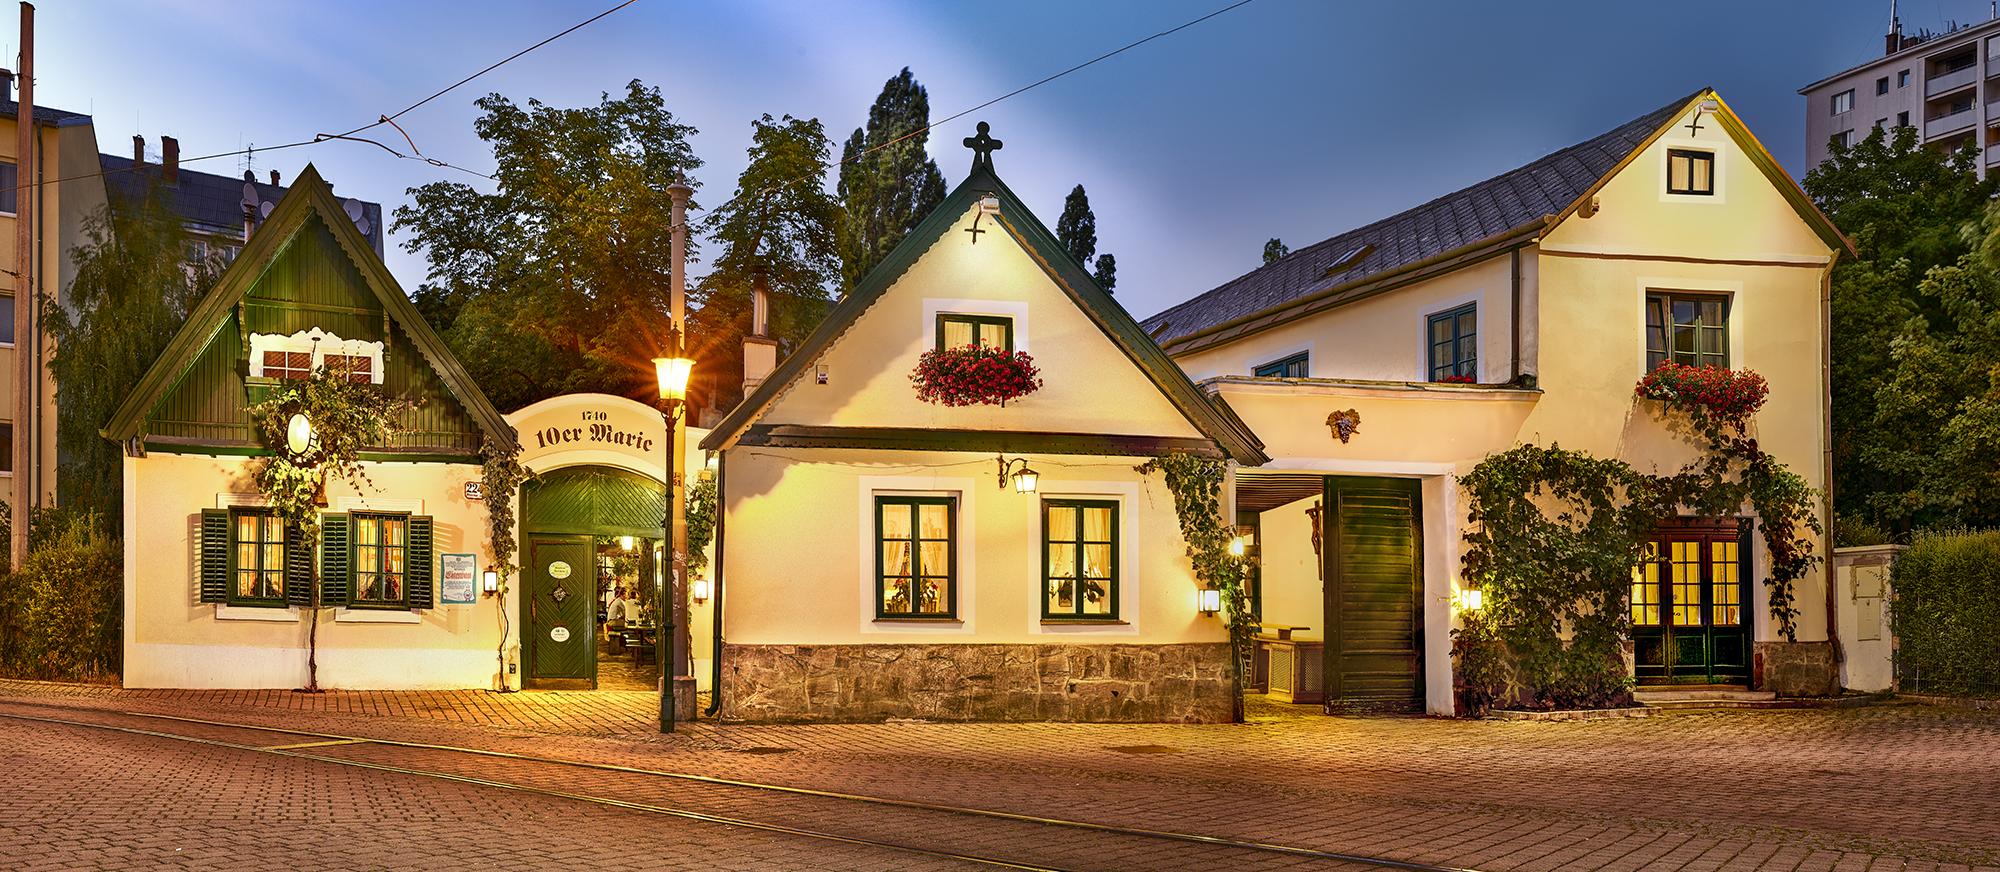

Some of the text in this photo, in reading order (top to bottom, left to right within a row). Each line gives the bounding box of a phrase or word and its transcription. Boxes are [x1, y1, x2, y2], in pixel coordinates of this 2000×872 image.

[582, 411, 607, 421] 1740
[536, 423, 653, 452] 10er Marie
